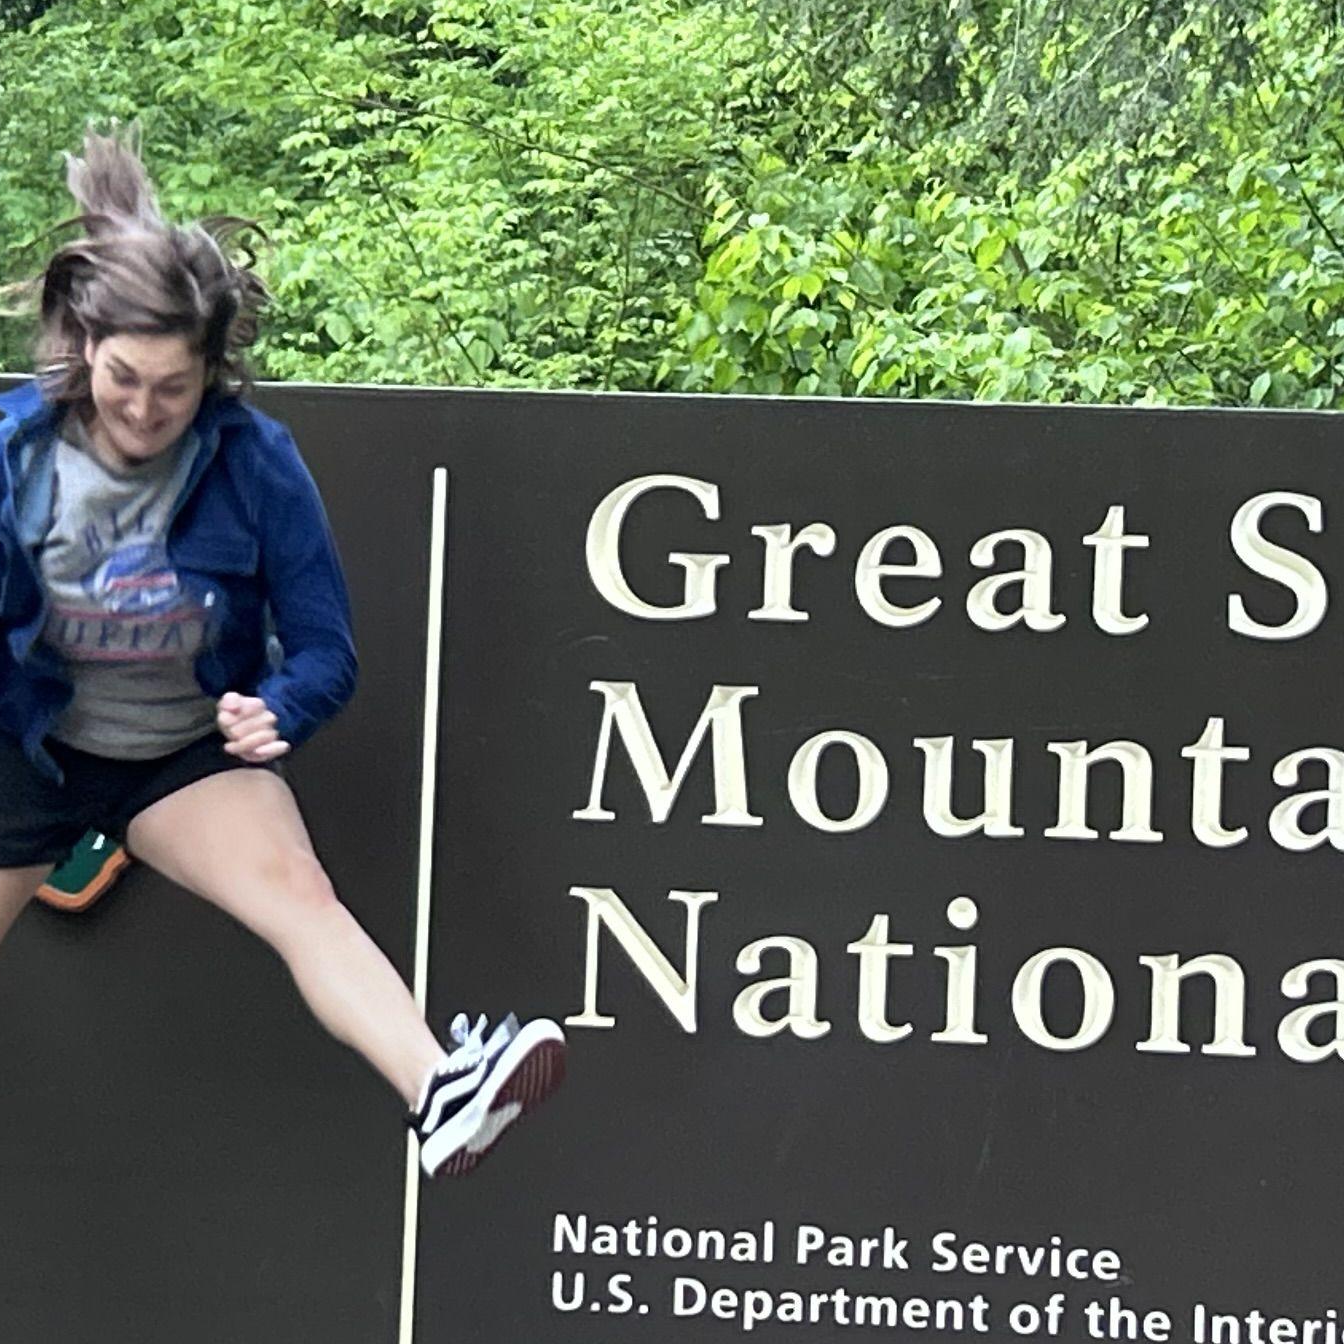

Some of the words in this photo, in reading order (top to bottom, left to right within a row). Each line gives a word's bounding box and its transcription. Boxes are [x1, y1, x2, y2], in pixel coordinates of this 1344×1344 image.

[585, 473, 1151, 635] Great
[552, 1213, 774, 1263] National
[796, 1223, 910, 1270] Park
[931, 1232, 1122, 1280] Service
[551, 1271, 649, 1315] U.S.
[672, 1277, 991, 1332] Department
[1009, 1293, 1066, 1335] of
[1082, 1296, 1173, 1343] the
